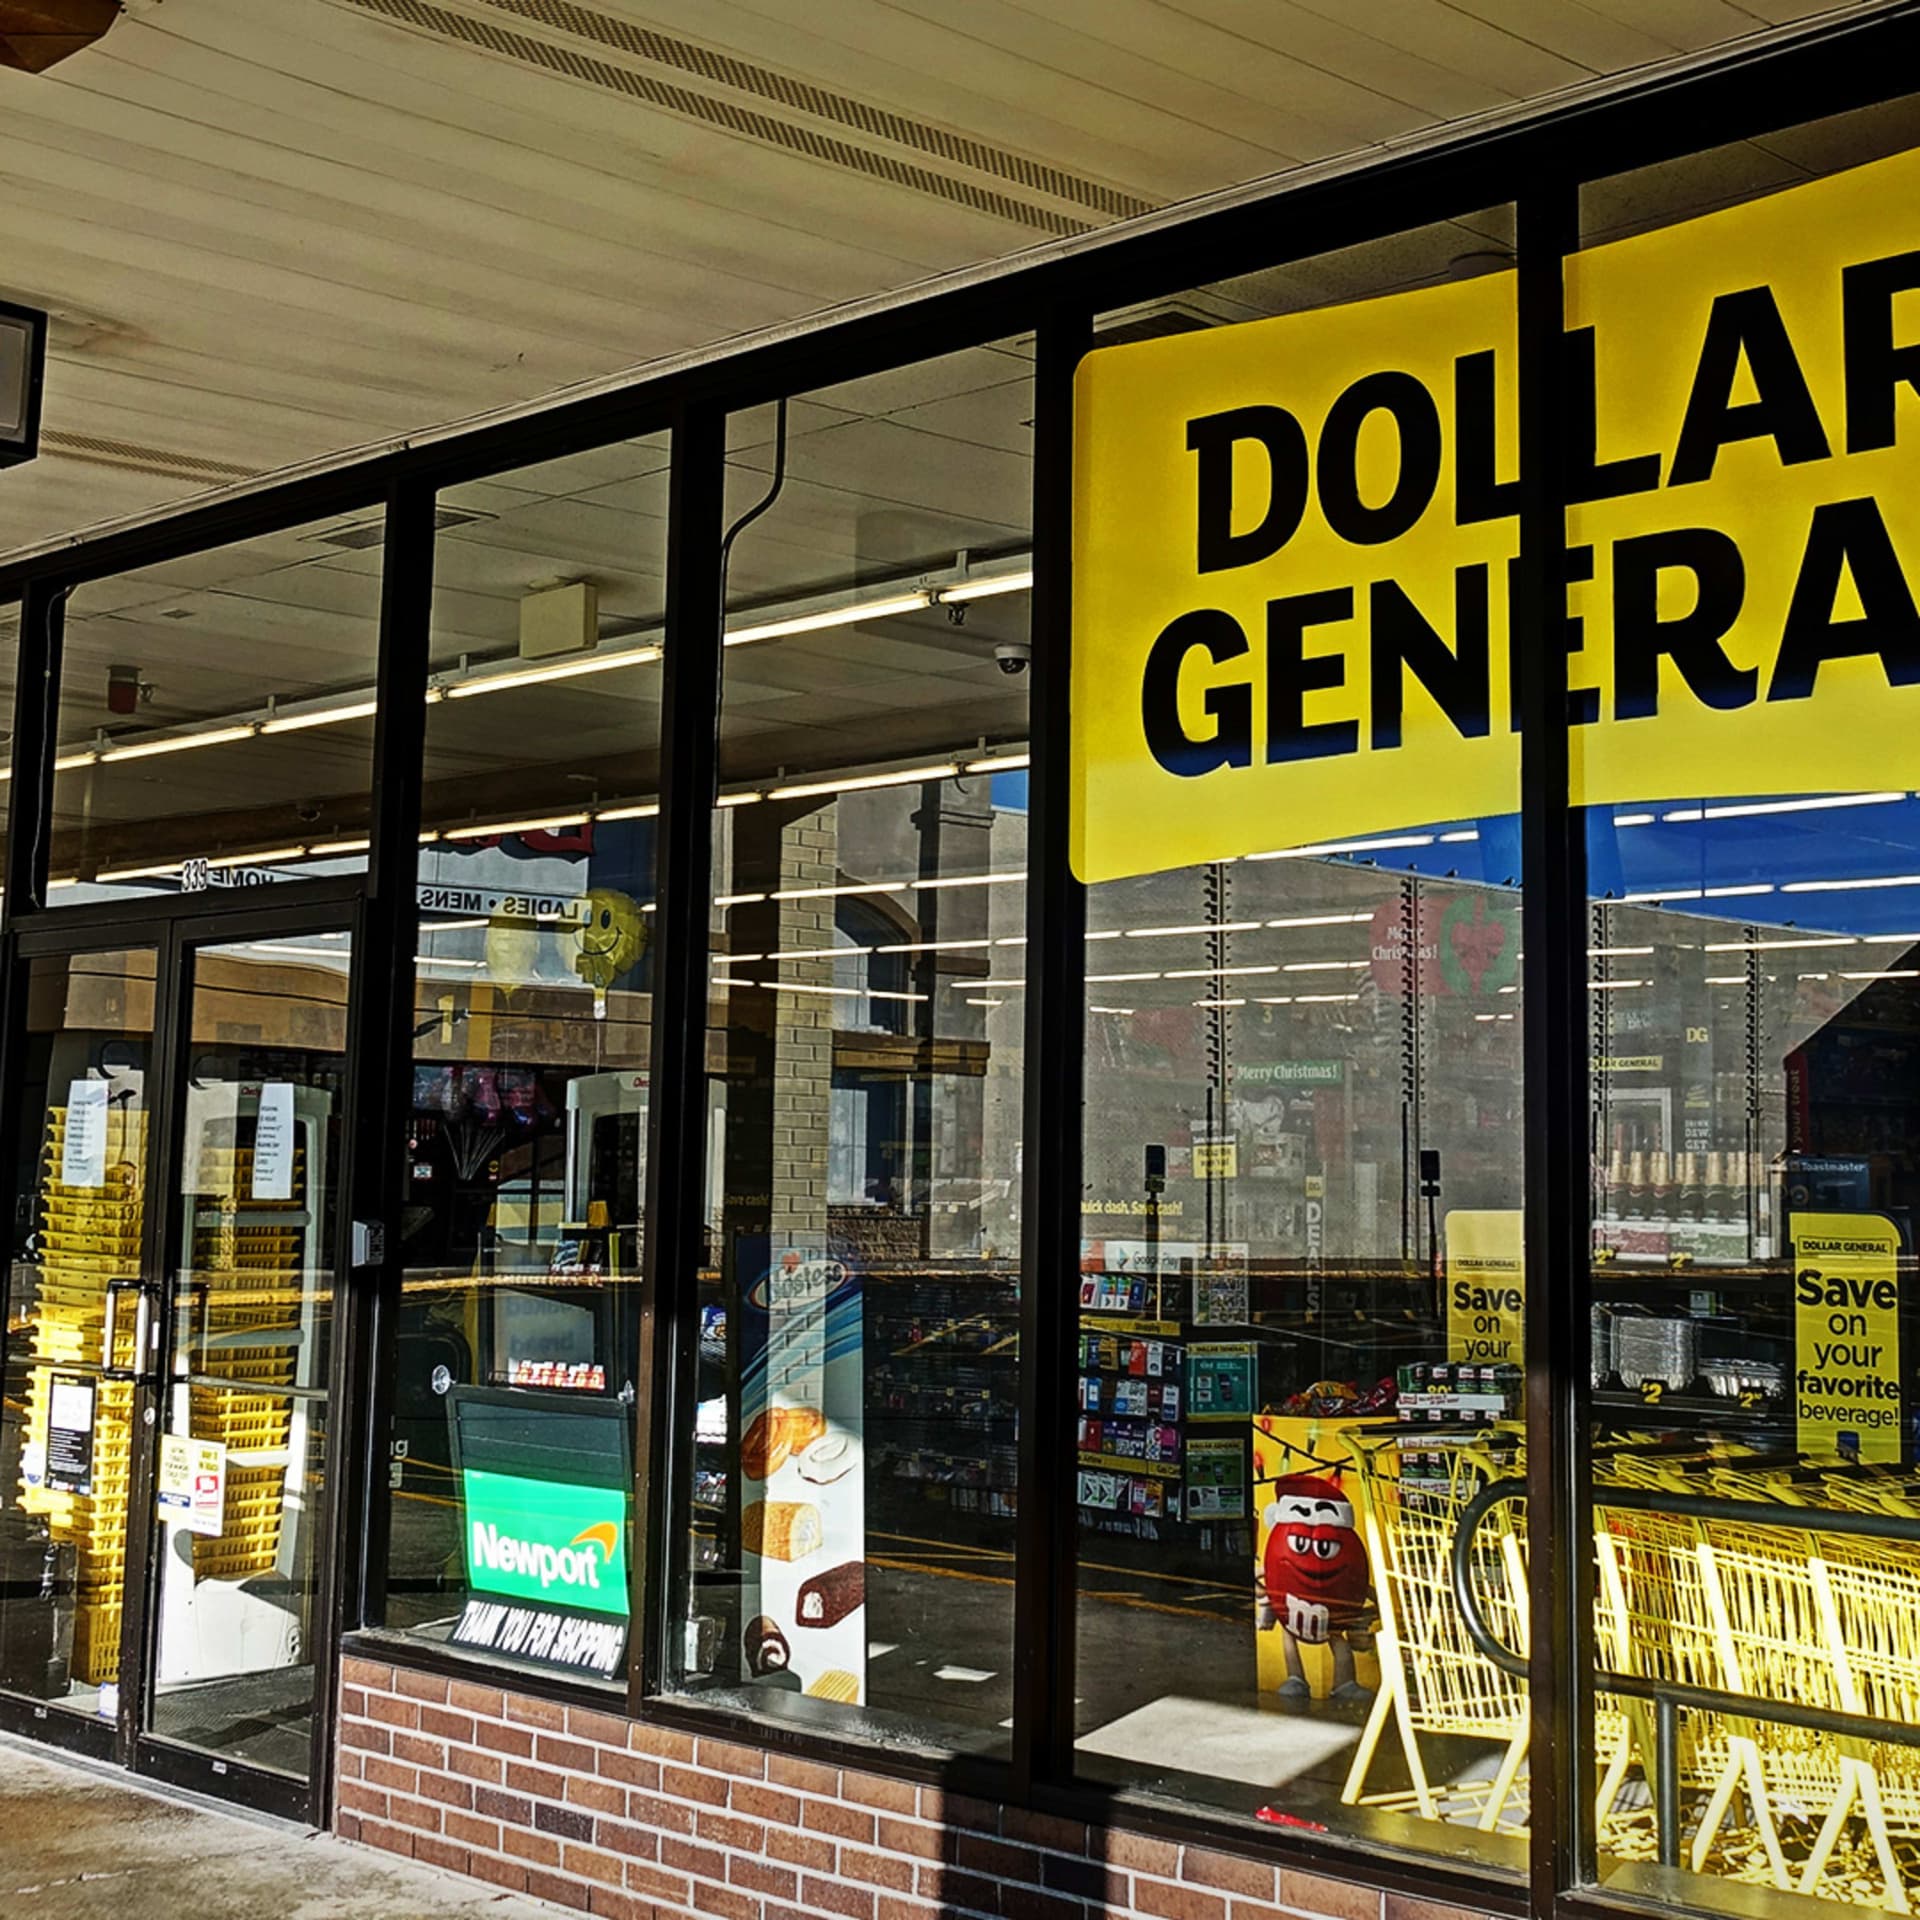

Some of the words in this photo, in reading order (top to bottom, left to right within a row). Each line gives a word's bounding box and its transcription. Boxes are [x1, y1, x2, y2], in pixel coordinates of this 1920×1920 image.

[182, 859, 208, 890] 339
[1387, 926, 1425, 942] Mey
[1685, 1027, 1709, 1043] DG
[1237, 1066, 1272, 1082] Merry
[1273, 1064, 1338, 1080] Christmas!
[1618, 1057, 1658, 1068] GENERAL
[1790, 1069, 1801, 1105] treat
[1791, 1111, 1803, 1144] your
[1685, 1139, 1709, 1150] GET
[1800, 1161, 1866, 1173] Toastmaster
[1081, 1200, 1103, 1214] uick
[1104, 1201, 1130, 1214] dash.
[1131, 1201, 1155, 1215] Save
[1156, 1201, 1183, 1216] cash!
[1802, 1240, 1842, 1251] DOLLAR
[1843, 1242, 1888, 1253] GENERAL
[1457, 1258, 1484, 1267] DOLLAR
[1485, 1259, 1516, 1268] GENERAL
[1453, 1281, 1523, 1312] Save
[1796, 1268, 1898, 1310] Save
[1473, 1315, 1501, 1333] on
[1828, 1313, 1867, 1336] on
[1464, 1339, 1512, 1361] your
[1813, 1342, 1883, 1370] your
[1641, 1382, 1663, 1404] $2
[1796, 1370, 1900, 1400] favorite
[1799, 1400, 1900, 1429] beverage!
[472, 1520, 600, 1589] Newport
[1285, 1592, 1330, 1641] m
[453, 1600, 510, 1648] THANK
[494, 1607, 536, 1653] YOU
[520, 1611, 562, 1658] FOR
[550, 1616, 625, 1673] SHOPPING
